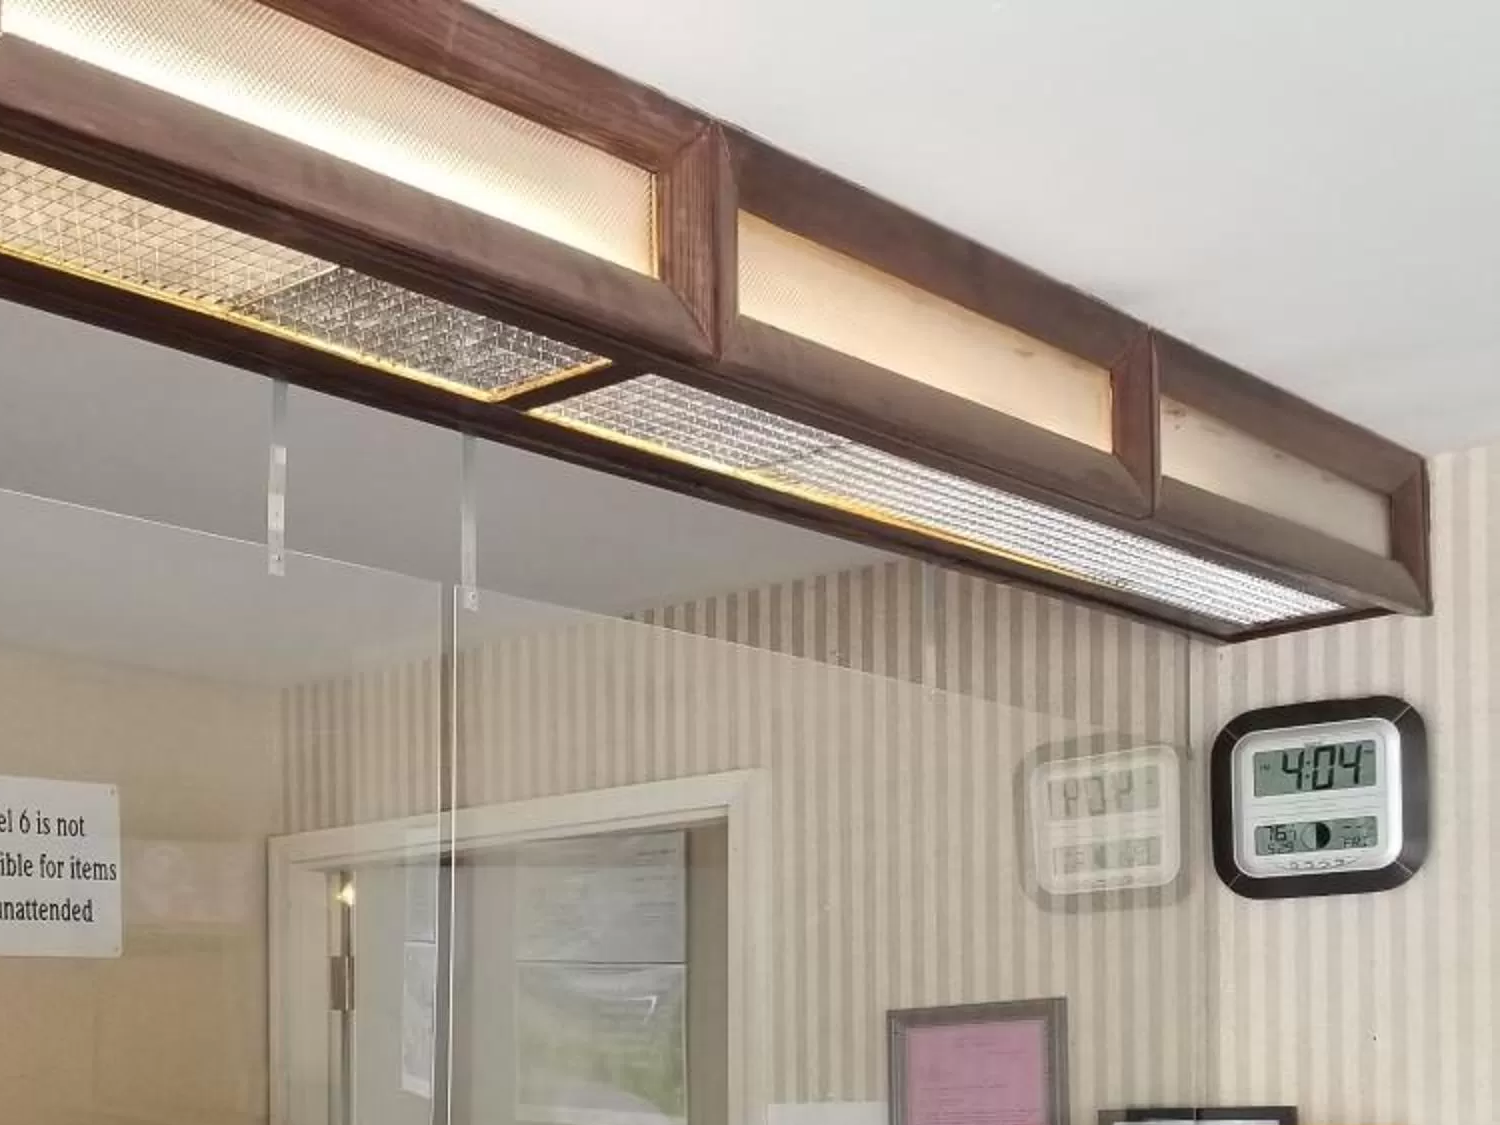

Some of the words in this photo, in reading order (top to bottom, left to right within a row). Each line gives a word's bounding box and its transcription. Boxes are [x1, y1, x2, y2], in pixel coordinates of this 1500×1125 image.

[1282, 745, 1362, 790] 4:04
[19, 808, 31, 834] 6
[36, 810, 50, 835] is
[57, 815, 85, 837] not
[39, 853, 64, 879] for
[70, 855, 117, 881] items
